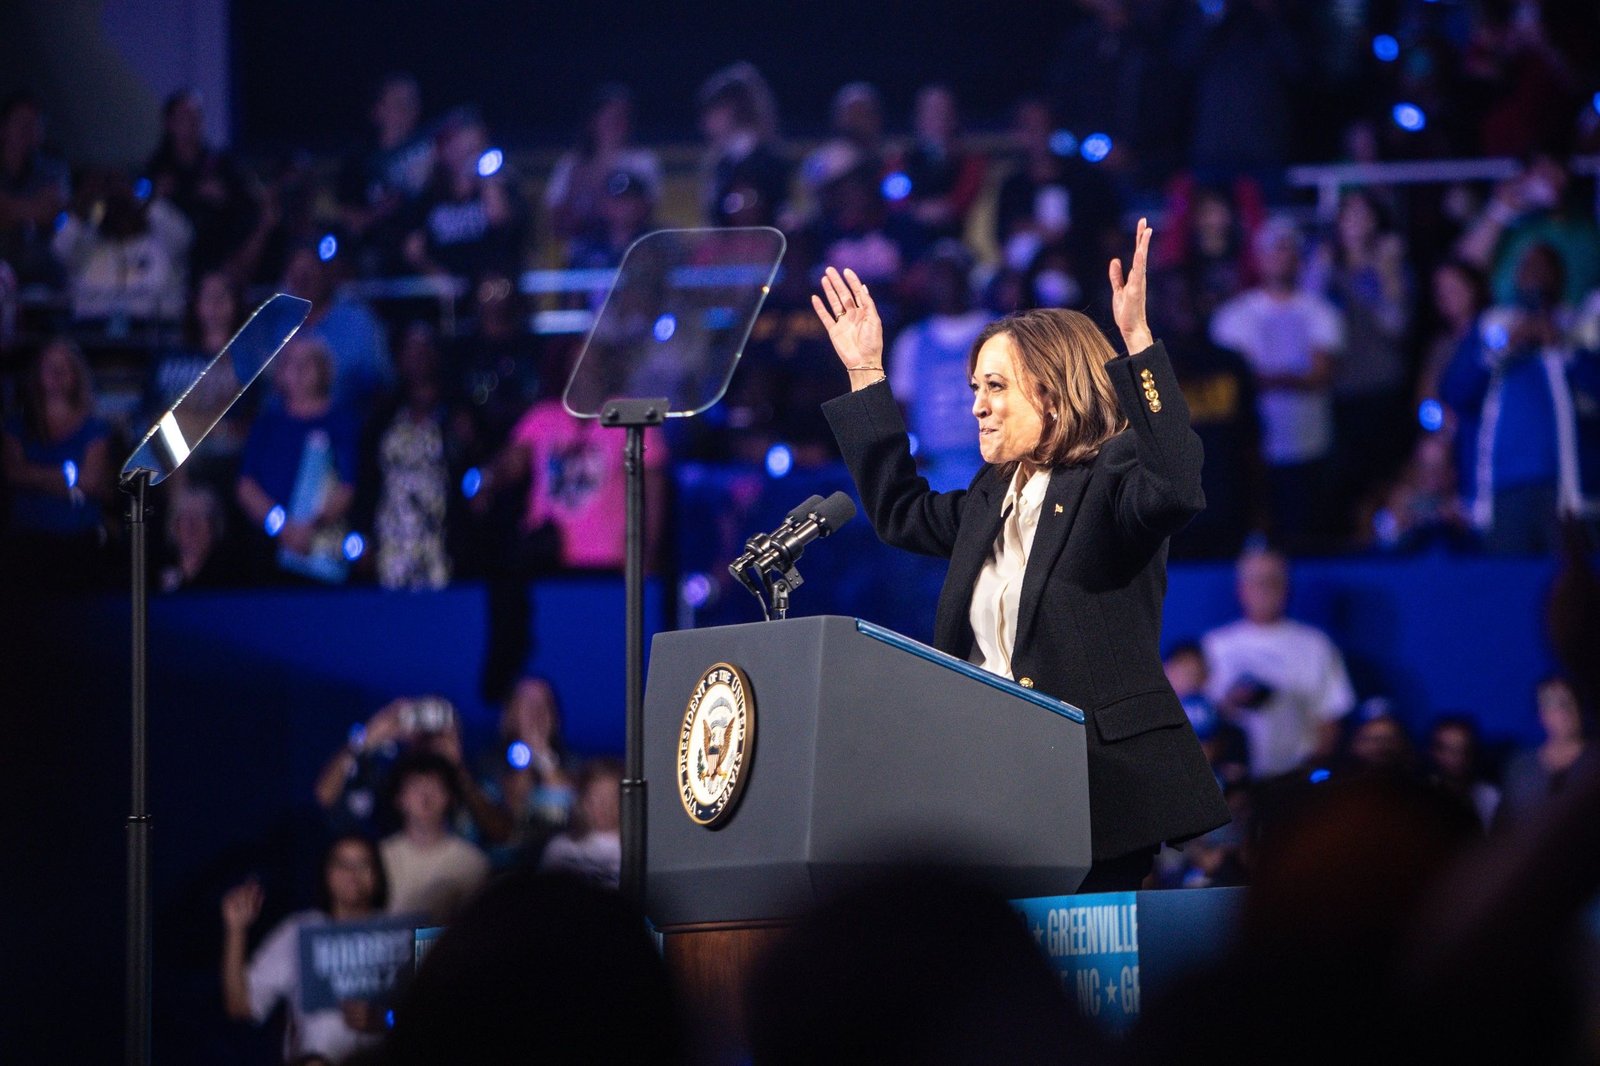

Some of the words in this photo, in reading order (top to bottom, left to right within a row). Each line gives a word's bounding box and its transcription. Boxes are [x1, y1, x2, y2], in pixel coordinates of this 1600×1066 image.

[708, 671, 720, 683] OF
[718, 669, 732, 684] THE
[680, 679, 706, 775] PRESIDENT
[731, 677, 746, 741] UNITED
[716, 752, 743, 813] STATES
[1046, 904, 1139, 957] GREENVILLE
[1076, 967, 1102, 1017] NC
